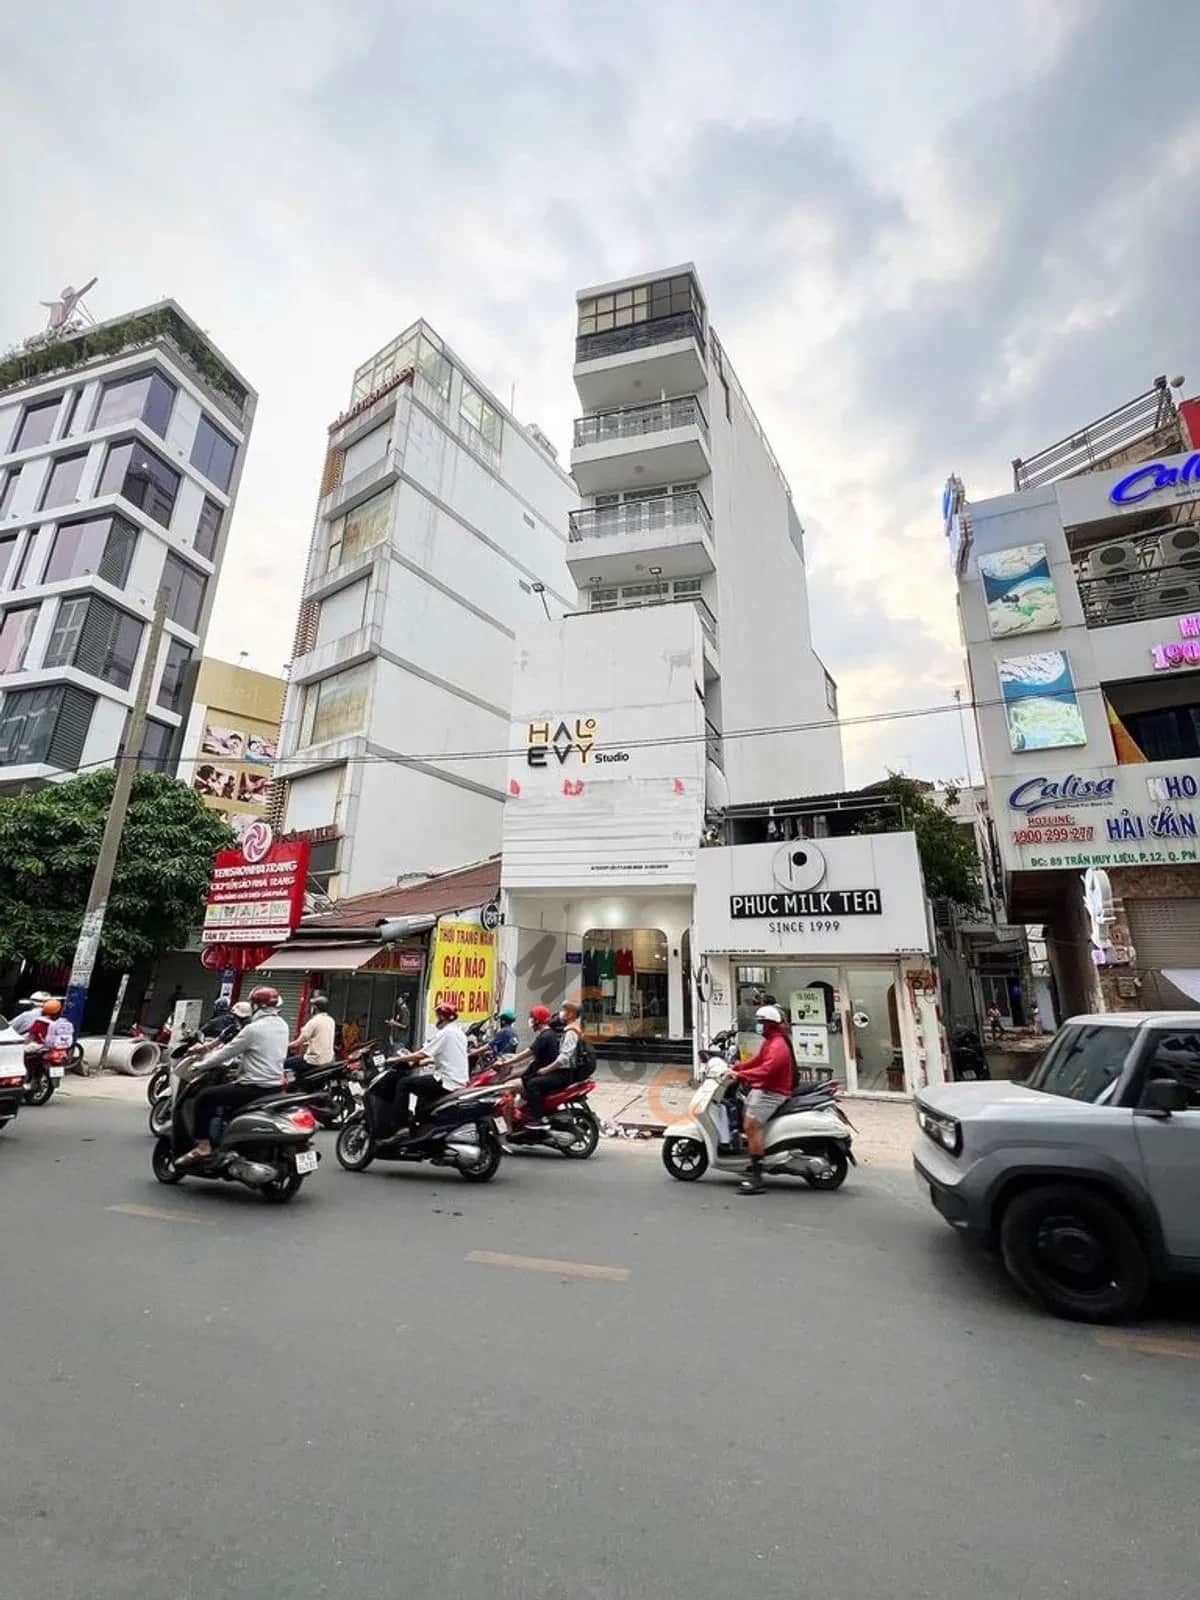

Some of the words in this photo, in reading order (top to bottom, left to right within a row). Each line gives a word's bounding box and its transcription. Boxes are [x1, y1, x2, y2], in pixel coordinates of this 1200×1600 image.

[527, 743, 595, 767] EVY
[594, 751, 630, 764] Studio
[1009, 774, 1116, 814] Calisa
[1013, 829, 1042, 844] 1900
[1044, 827, 1070, 842] 299
[1106, 808, 1145, 841] HẢI
[732, 895, 779, 916] PHUC
[784, 892, 833, 915] MILK
[839, 890, 879, 913] TEA
[768, 922, 804, 934] SINCE
[810, 920, 840, 933] 1999
